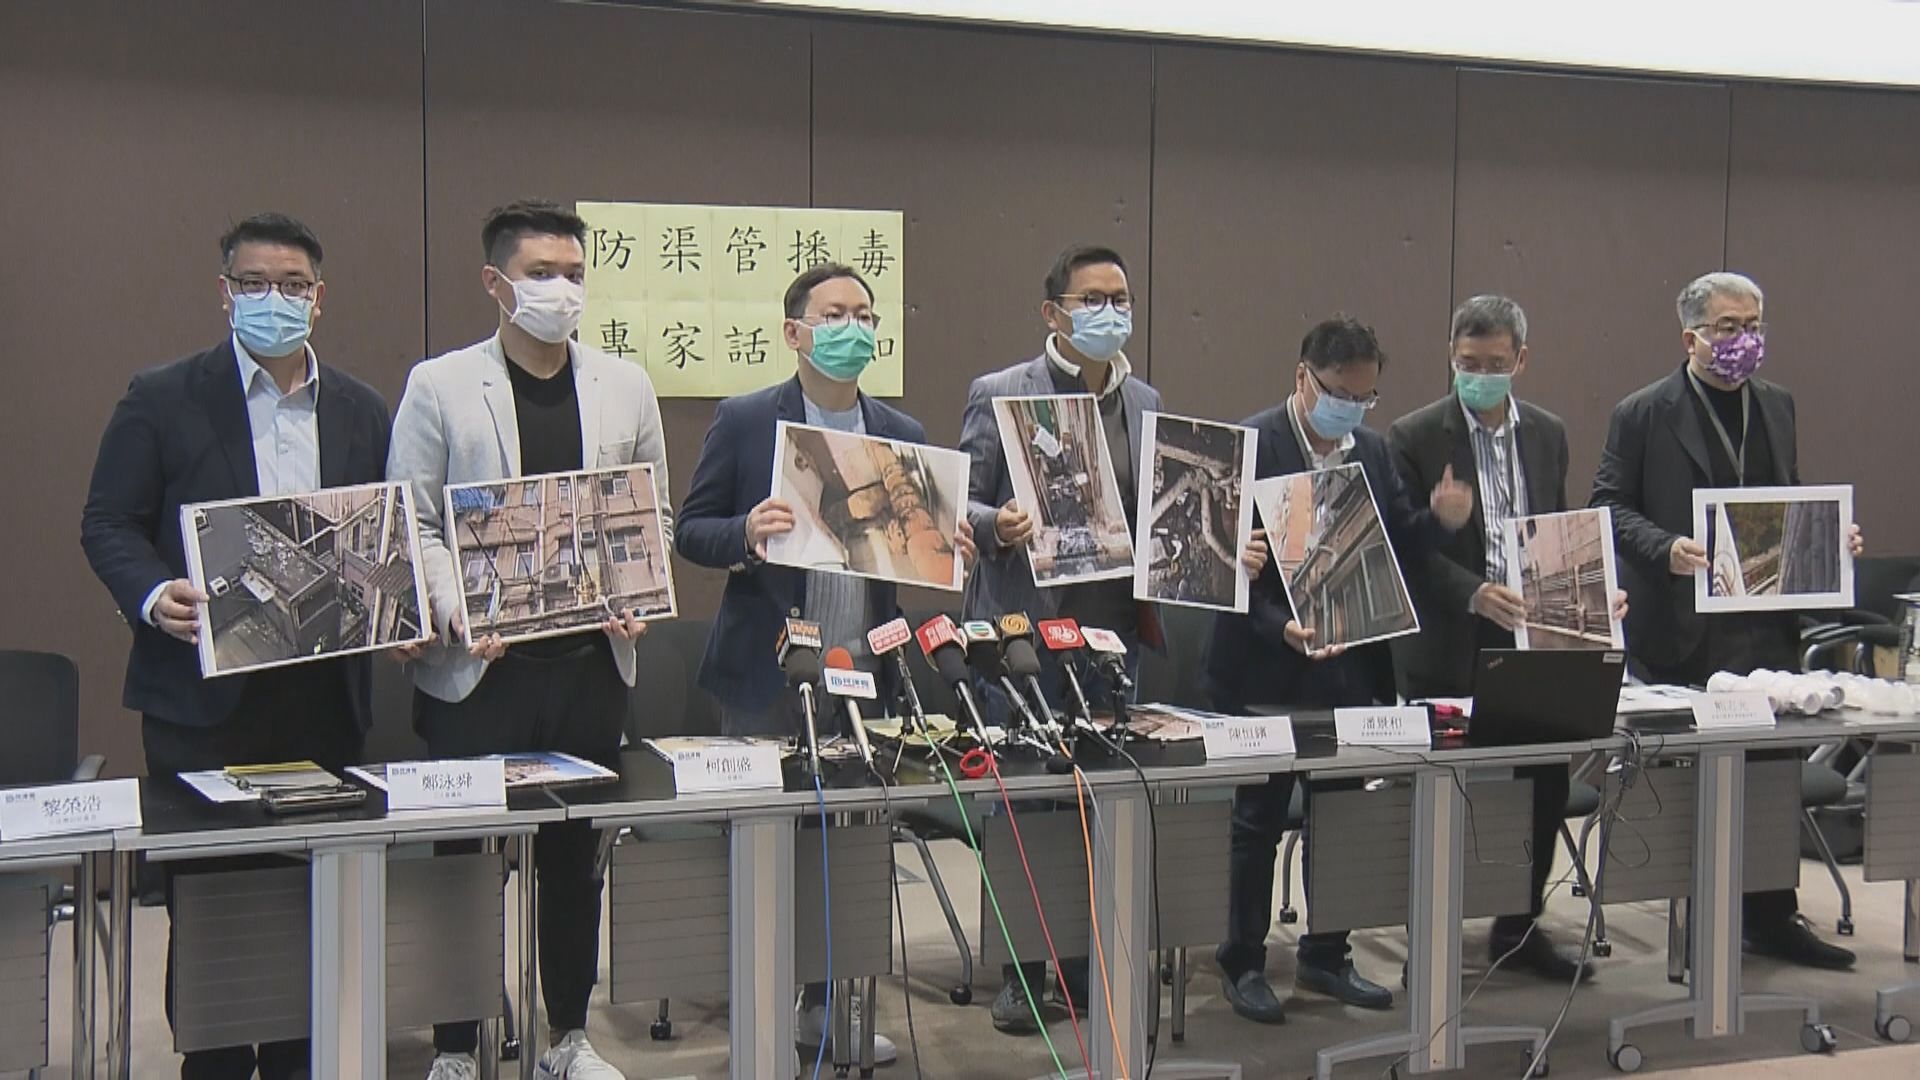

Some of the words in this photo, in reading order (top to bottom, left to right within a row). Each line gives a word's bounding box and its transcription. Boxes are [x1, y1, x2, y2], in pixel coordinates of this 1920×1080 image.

[593, 226, 896, 277] 防渠管播毒
[600, 318, 895, 369] 專家話
